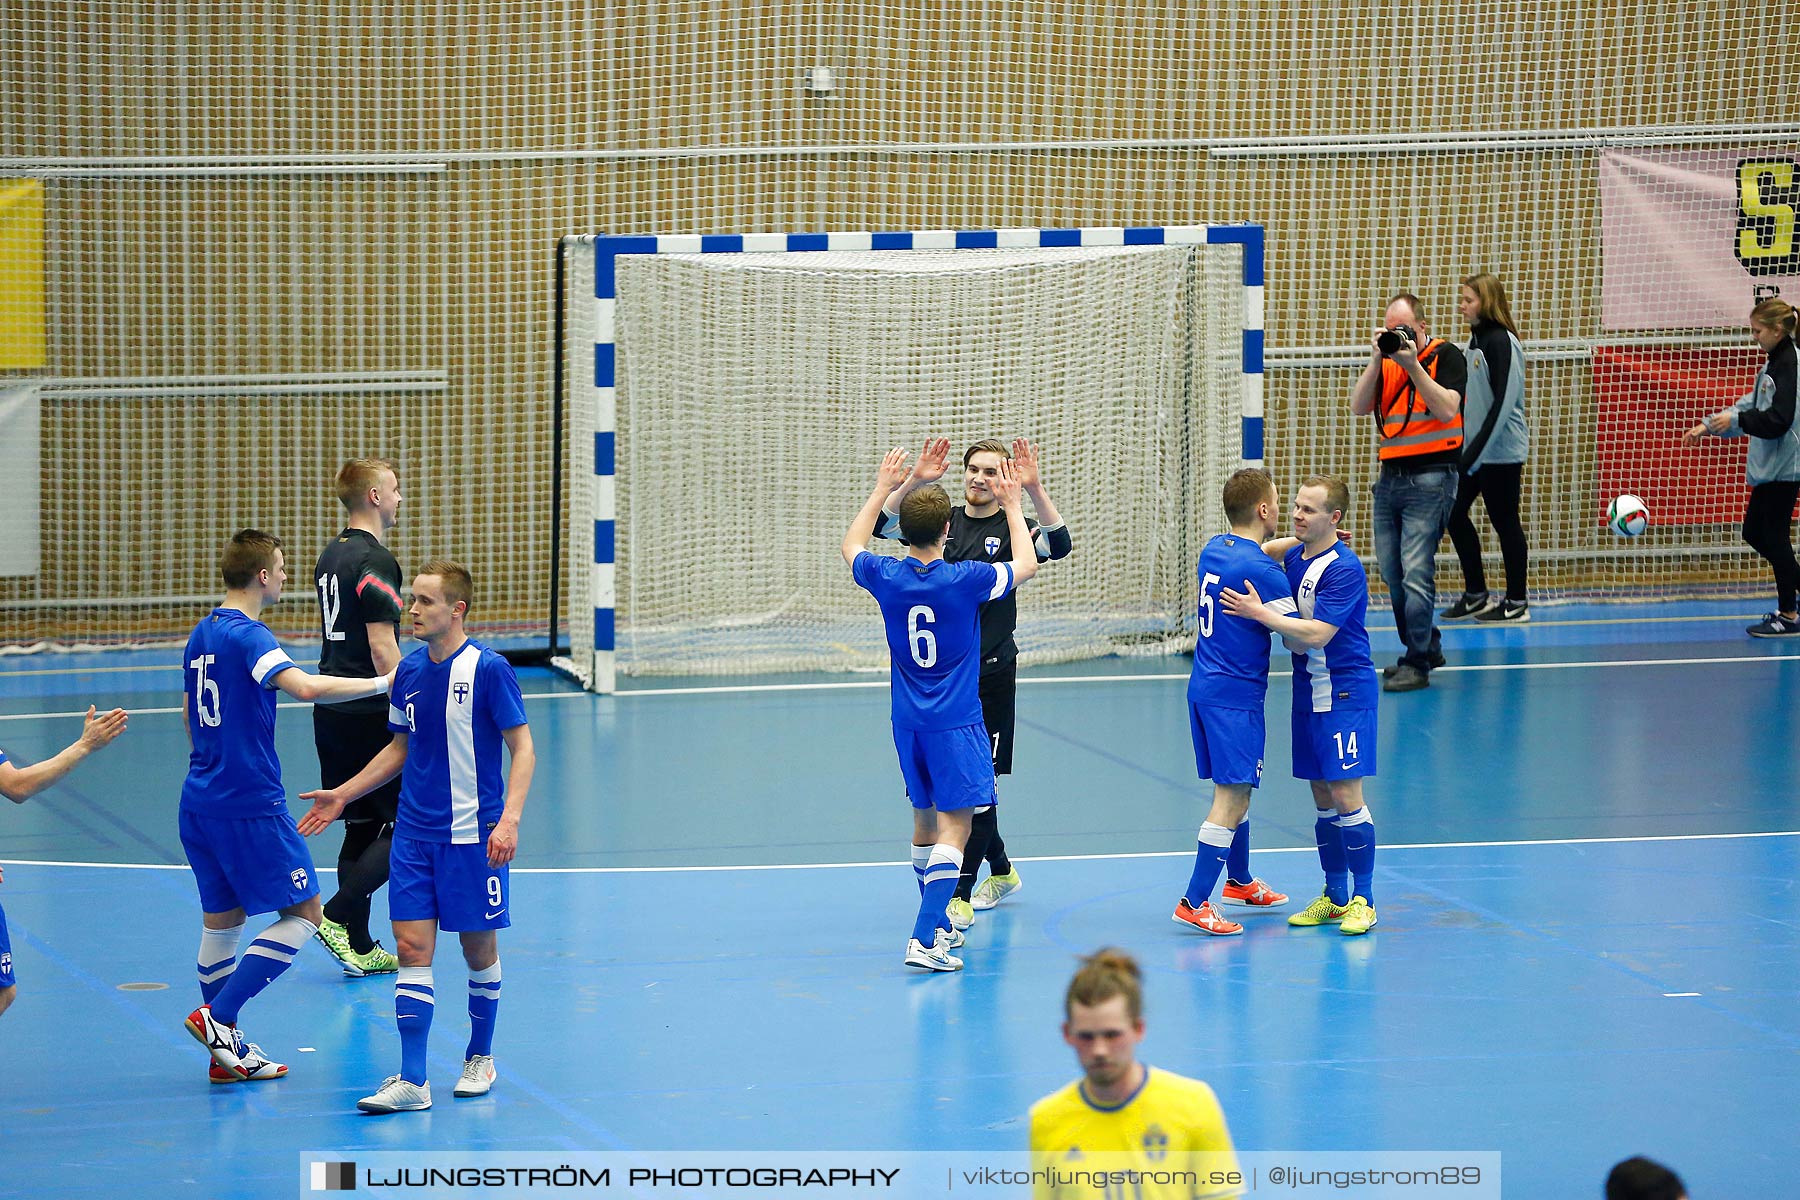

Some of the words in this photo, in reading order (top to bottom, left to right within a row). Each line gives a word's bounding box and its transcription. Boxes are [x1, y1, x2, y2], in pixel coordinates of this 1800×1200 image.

[1737, 159, 1797, 264] S
[318, 573, 345, 641] 12
[908, 605, 937, 668] 6
[1200, 572, 1220, 638] 5
[190, 654, 222, 728] 15
[406, 702, 416, 733] 9
[1333, 731, 1358, 759] 14
[486, 875, 502, 907] 9
